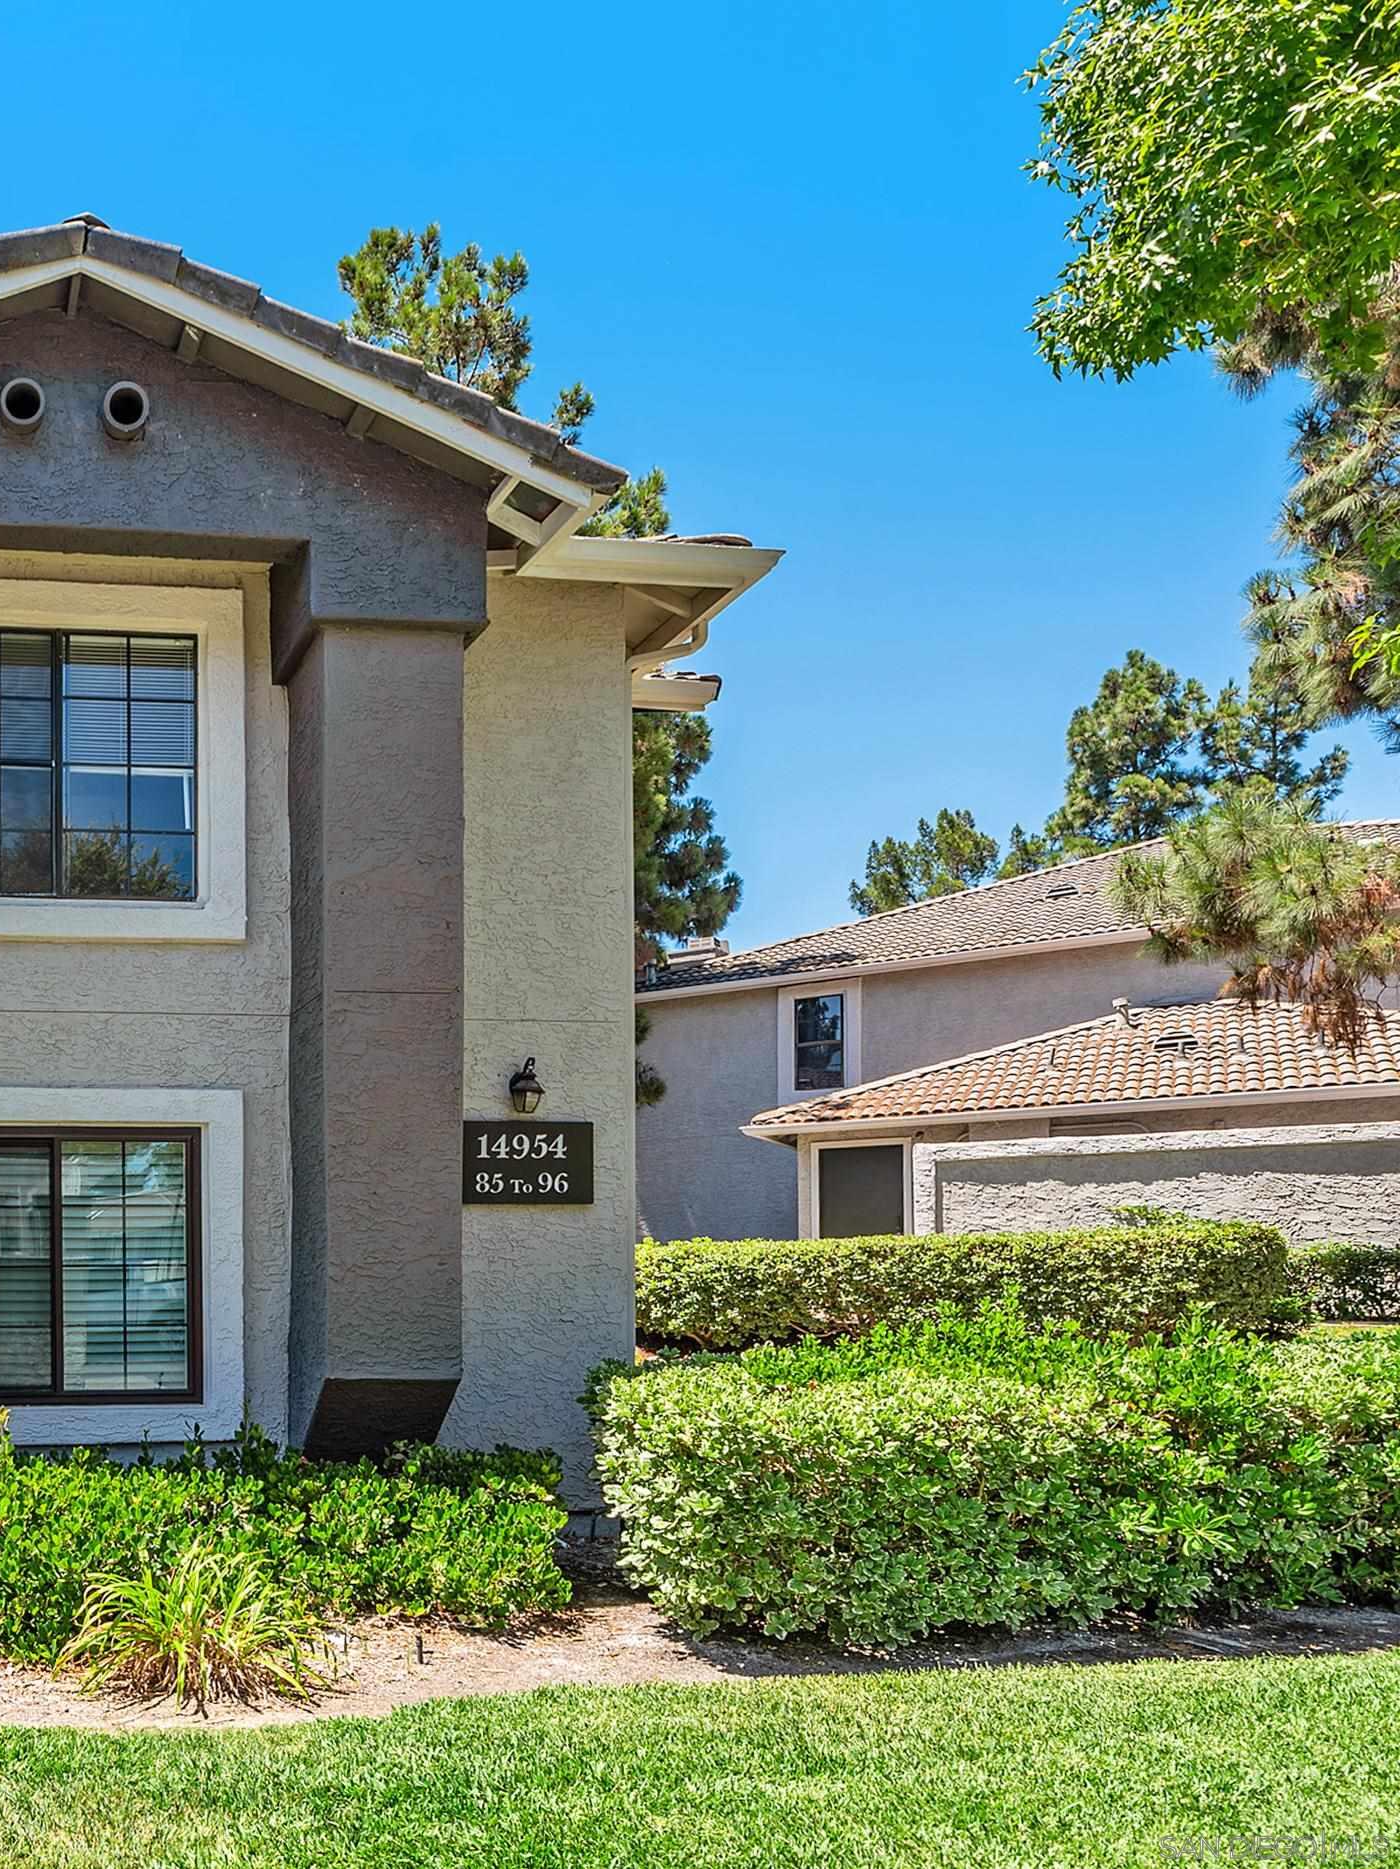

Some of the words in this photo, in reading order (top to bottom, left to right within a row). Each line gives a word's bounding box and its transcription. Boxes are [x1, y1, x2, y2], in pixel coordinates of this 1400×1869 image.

[476, 1133, 567, 1159] 14954
[475, 1172, 504, 1193] 85
[510, 1179, 533, 1193] To
[538, 1172, 569, 1193] 96
